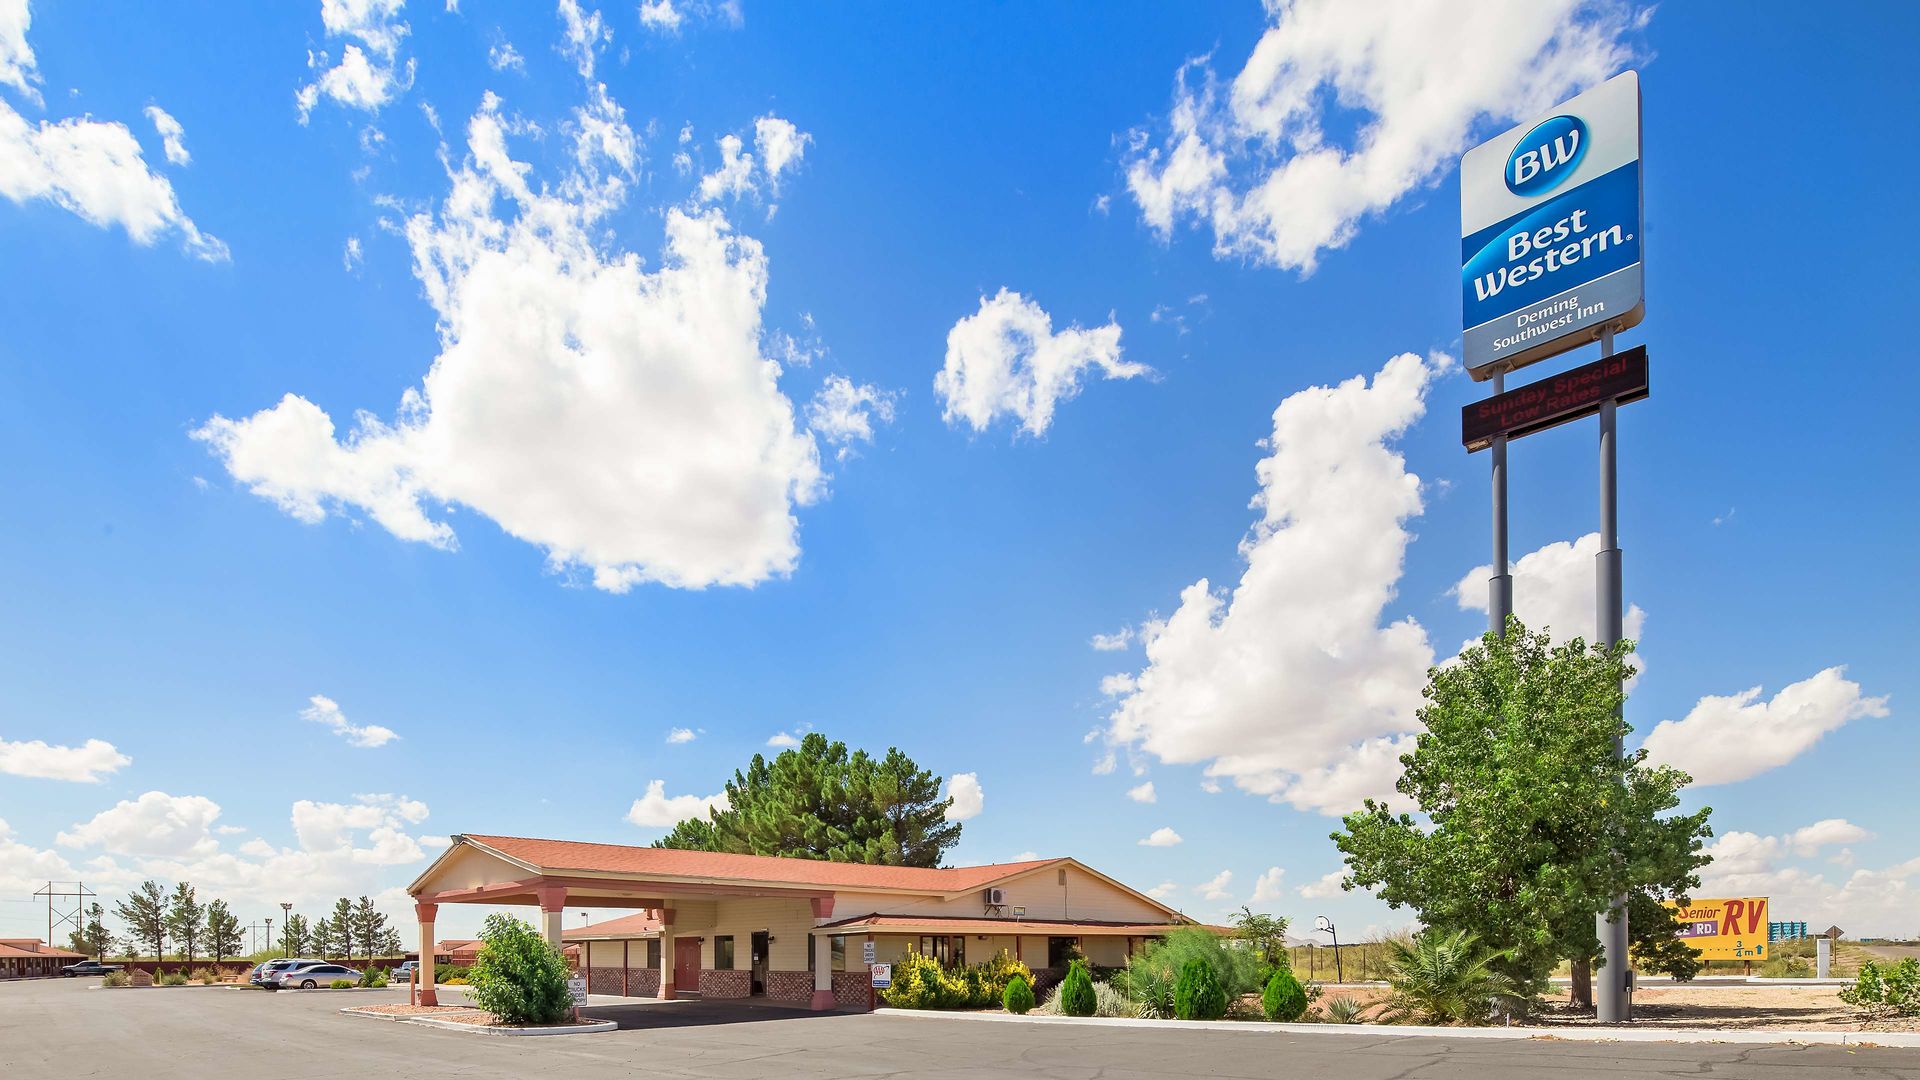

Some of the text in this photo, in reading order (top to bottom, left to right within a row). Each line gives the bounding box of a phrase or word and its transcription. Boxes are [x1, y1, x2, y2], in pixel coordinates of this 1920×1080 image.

[1514, 129, 1579, 186] BW
[1508, 209, 1588, 262] Best
[1474, 224, 1624, 302] Western
[1493, 301, 1605, 351] Southwest Inn
[1517, 295, 1578, 328] Deming
[1479, 357, 1627, 418] Sunday Special
[1501, 386, 1600, 427] Low Rates
[1679, 900, 1765, 935] Senior RV
[1696, 923, 1716, 935] RD.
